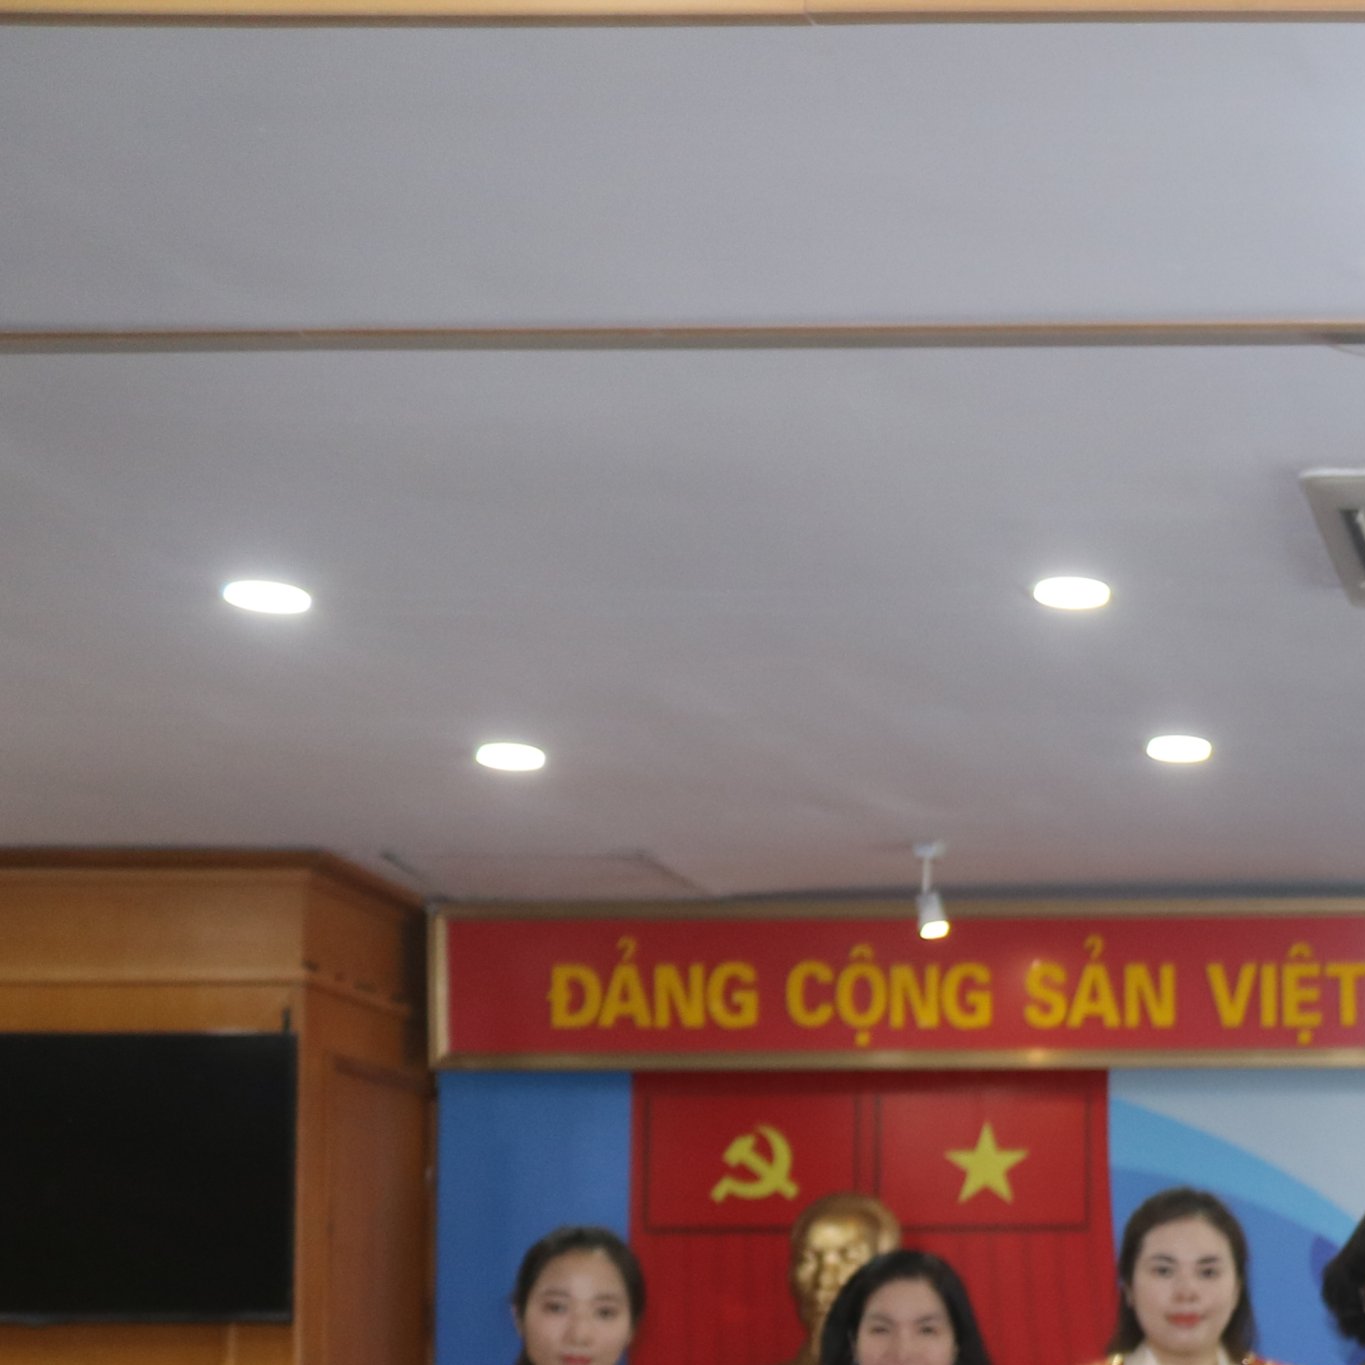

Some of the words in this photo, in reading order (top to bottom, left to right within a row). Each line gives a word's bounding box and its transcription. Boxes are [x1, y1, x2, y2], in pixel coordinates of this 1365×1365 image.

[547, 936, 760, 1030] ĐẢNG
[786, 944, 993, 1046] CỘNG
[1023, 935, 1176, 1030] SẢN
